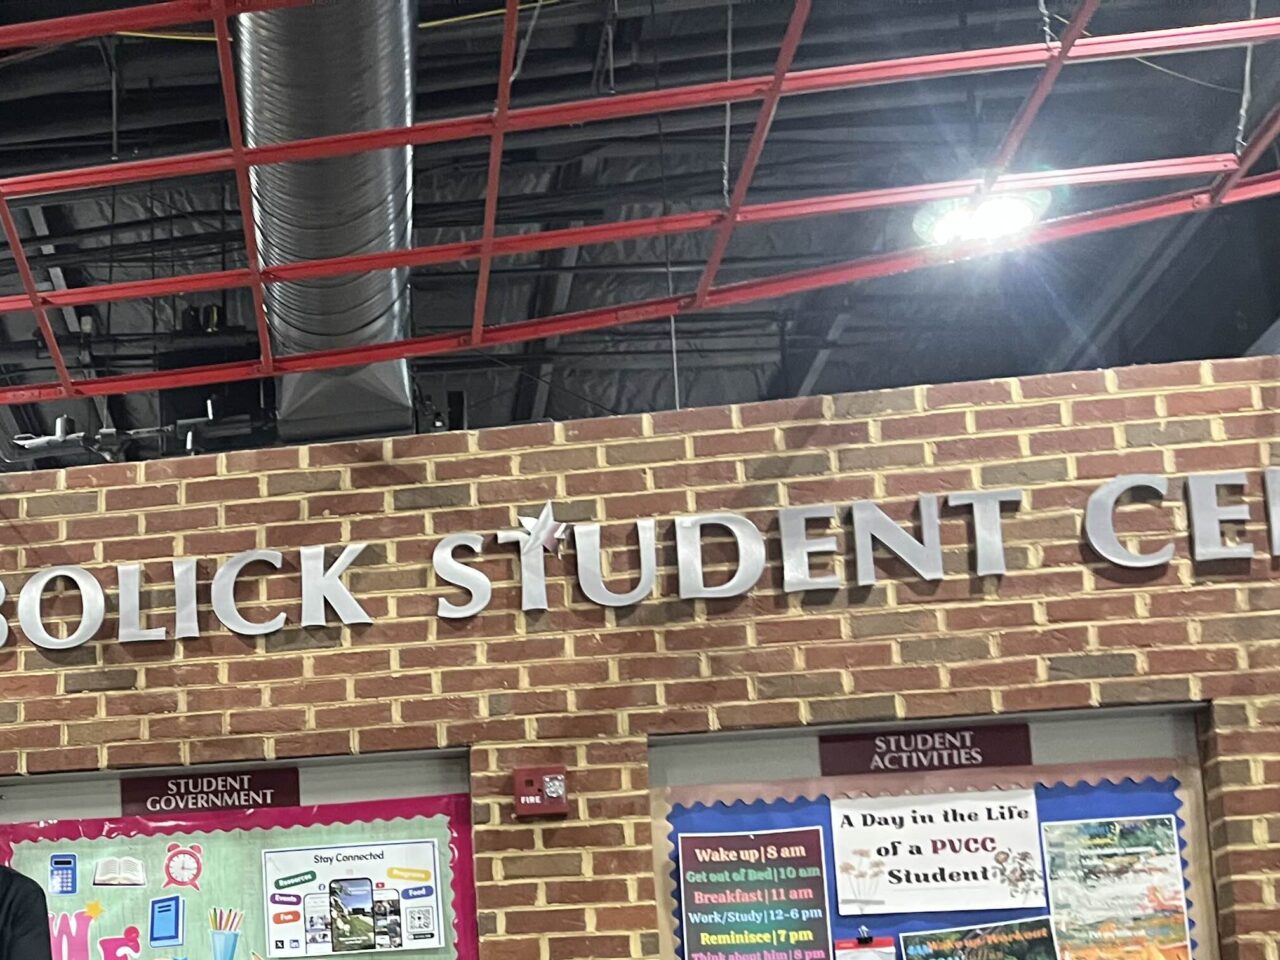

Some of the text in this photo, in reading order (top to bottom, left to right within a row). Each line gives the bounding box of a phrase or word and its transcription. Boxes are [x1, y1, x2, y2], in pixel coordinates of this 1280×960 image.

[432, 489, 1021, 618] STUDENT
[874, 731, 974, 753] STUDENT
[870, 748, 983, 770] ACTIVITIES
[167, 776, 251, 795] STUDENT
[147, 789, 274, 812] GOVERNMENT
[521, 796, 541, 804] FIRE
[840, 806, 1029, 829] A Day in the Life
[695, 849, 738, 862] Wake
[780, 845, 806, 857] am
[876, 837, 997, 857] of a PVCC
[314, 851, 384, 865] Stay Connected
[686, 871, 707, 883] Get
[709, 871, 729, 882] out
[731, 869, 745, 881] of
[799, 867, 820, 877] am
[888, 867, 990, 884] Student
[789, 888, 813, 899] am
[802, 908, 822, 921] pm
[789, 930, 813, 943] pm
[804, 949, 825, 960] pm
